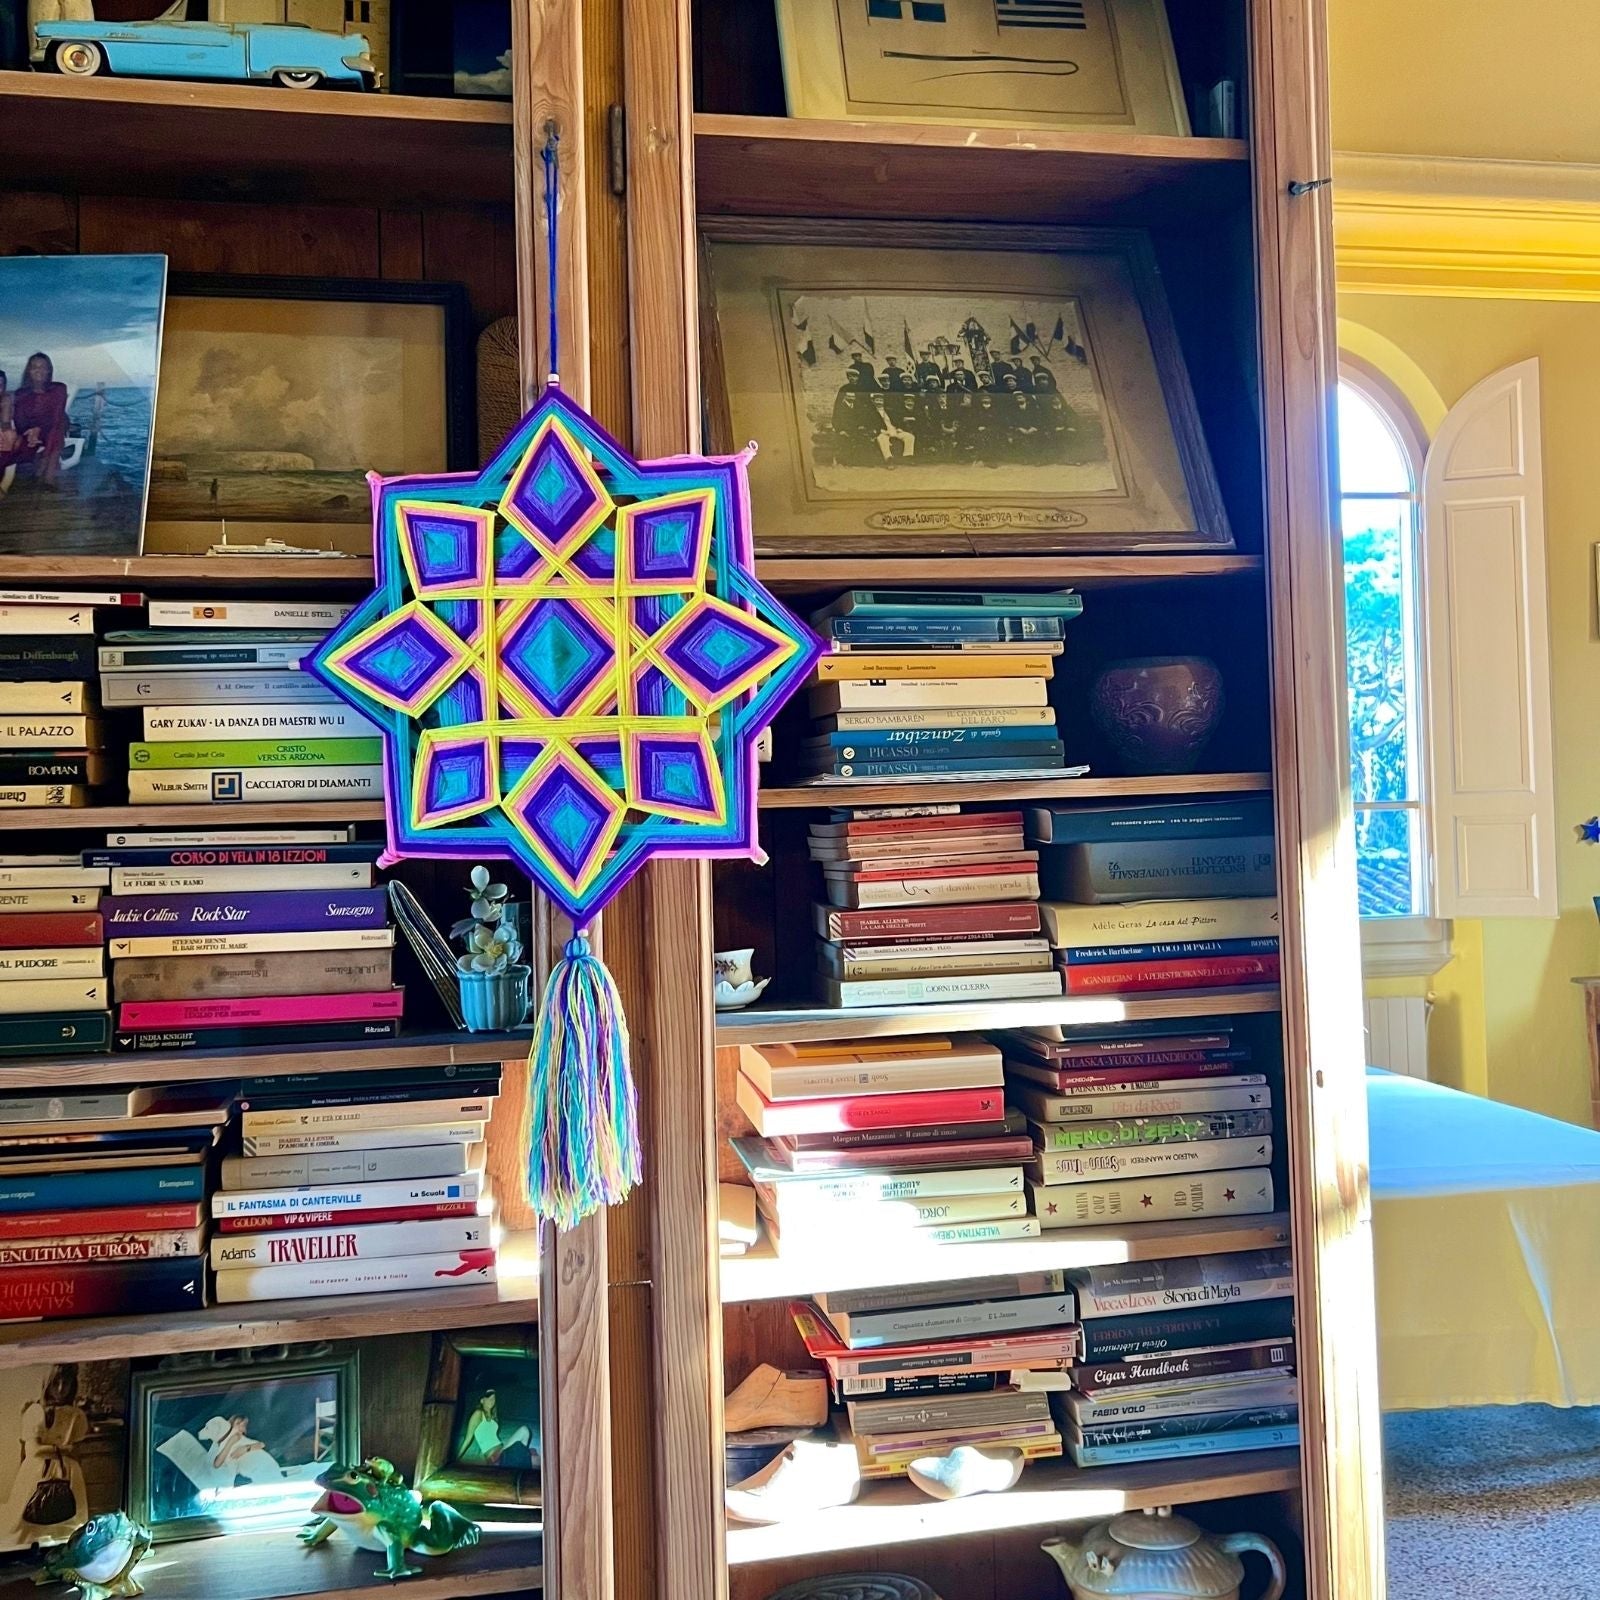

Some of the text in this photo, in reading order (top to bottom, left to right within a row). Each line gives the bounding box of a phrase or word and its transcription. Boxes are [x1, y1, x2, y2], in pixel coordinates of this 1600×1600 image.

[36, 593, 60, 601] Firenze
[274, 609, 334, 618] DANIELLE STEEL
[23, 650, 79, 663] Diffenbaugh
[844, 714, 925, 725] SERGIO BAMBARÉN
[946, 708, 1019, 718] IL GUARDIANO
[150, 716, 345, 729] GARY ZUKAV LA DANZA DEI MAESTRI WU LI
[960, 715, 1006, 725] DEL FARO
[7, 725, 75, 737] IL PALAZZO
[887, 728, 1001, 744] Guida di Zanzibar
[173, 751, 195, 760] Camilo
[196, 751, 209, 760] José
[276, 745, 307, 754] CRISTO
[868, 747, 919, 758] PICASSO
[257, 752, 326, 762] VERSUS ARIZONA
[28, 765, 78, 776] BOMPIANI
[867, 764, 918, 776] PICASSO
[152, 781, 208, 792] WILBUR SMITH
[245, 778, 372, 789] CACCIATORI DI DIAMANTI
[170, 849, 326, 865] CORSO DI VELA IN 18 LEZIONI
[1191, 854, 1246, 866] GARZANTI
[1109, 863, 1246, 880] ENCICLOPEDIA UNIVERSALE
[1000, 880, 1022, 892] prada
[110, 905, 251, 923] Jackie Collins Rock Star
[325, 903, 374, 918] Sonzogno
[882, 917, 909, 925] ALLENDE
[1091, 916, 1217, 931] Adèle Geras La casa del Pittore
[1075, 938, 1280, 959] Frederick Barthelme FUOCO DI PAGLIA BOMPIA
[0, 960, 12, 969] AL
[14, 958, 58, 969] PUDORE
[1081, 972, 1149, 985] AGANBEGIAN LA
[925, 983, 991, 993] GIORNI DI GUERRA
[139, 1032, 194, 1042] INDIA KNIGHT
[1062, 1054, 1145, 1070] ALASKA-YUKON
[1146, 1049, 1207, 1065] HANDBOOK
[870, 1073, 889, 1082] Snob
[1112, 1096, 1182, 1114] Vita da Ricchi
[832, 1128, 957, 1144] Margaret Mazzantini Il di zinco
[1055, 1121, 1236, 1147] MENO DI ZERO Ellis
[1056, 1152, 1199, 1176] VALERIO MANFREDI SCUDO TALOS
[421, 1189, 446, 1197] Scuola
[1174, 1190, 1187, 1207] RED
[227, 1194, 362, 1211] IL FANTASMA DI CANTERVILLE
[436, 1202, 466, 1212] RIZZOLI
[1076, 1191, 1089, 1220] MARTIN
[1093, 1195, 1106, 1216] CRUZ
[1108, 1191, 1121, 1216] SMITH
[232, 1211, 333, 1229] GOLDONI VIP VIPERE
[957, 1226, 1001, 1239] VALENTINA
[0, 1241, 147, 1263] ENULTIMA EUROPA
[221, 1233, 359, 1263] Adams TRAVELLER
[0, 1279, 75, 1299] RUSHDIE
[1162, 1284, 1241, 1305] Storia di Mayta
[892, 1320, 924, 1331] Cinquanta
[924, 1318, 955, 1329] sfumature
[955, 1317, 962, 1325] di
[1093, 1339, 1168, 1354] Olivia Lichtenstein
[1094, 1368, 1127, 1386] Cigar
[1130, 1358, 1190, 1380] Handbook
[1092, 1407, 1119, 1418] FABIO
[1121, 1404, 1146, 1416] VOLO
